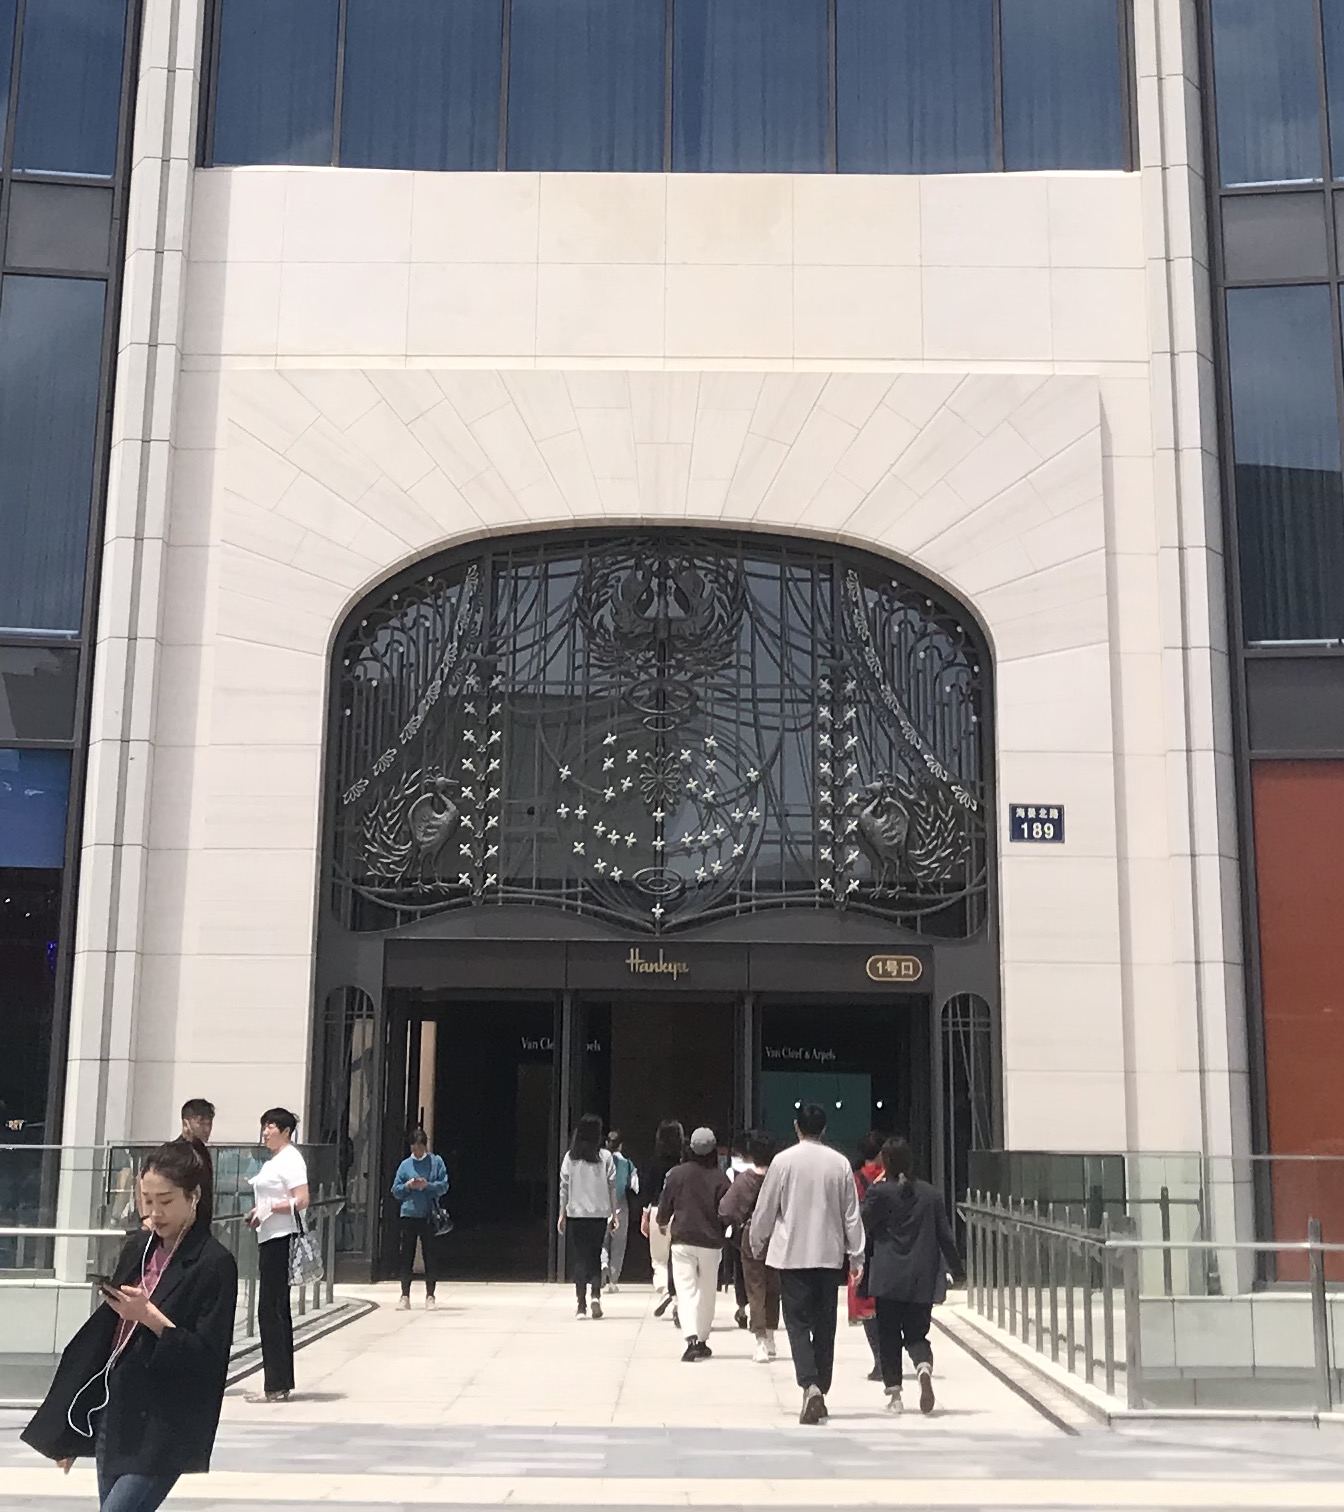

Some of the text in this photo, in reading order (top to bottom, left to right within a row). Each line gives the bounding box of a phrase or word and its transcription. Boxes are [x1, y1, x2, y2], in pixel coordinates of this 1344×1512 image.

[1020, 822, 1054, 839] 189
[625, 947, 690, 981] Hankyu
[876, 960, 914, 977] 1号口
